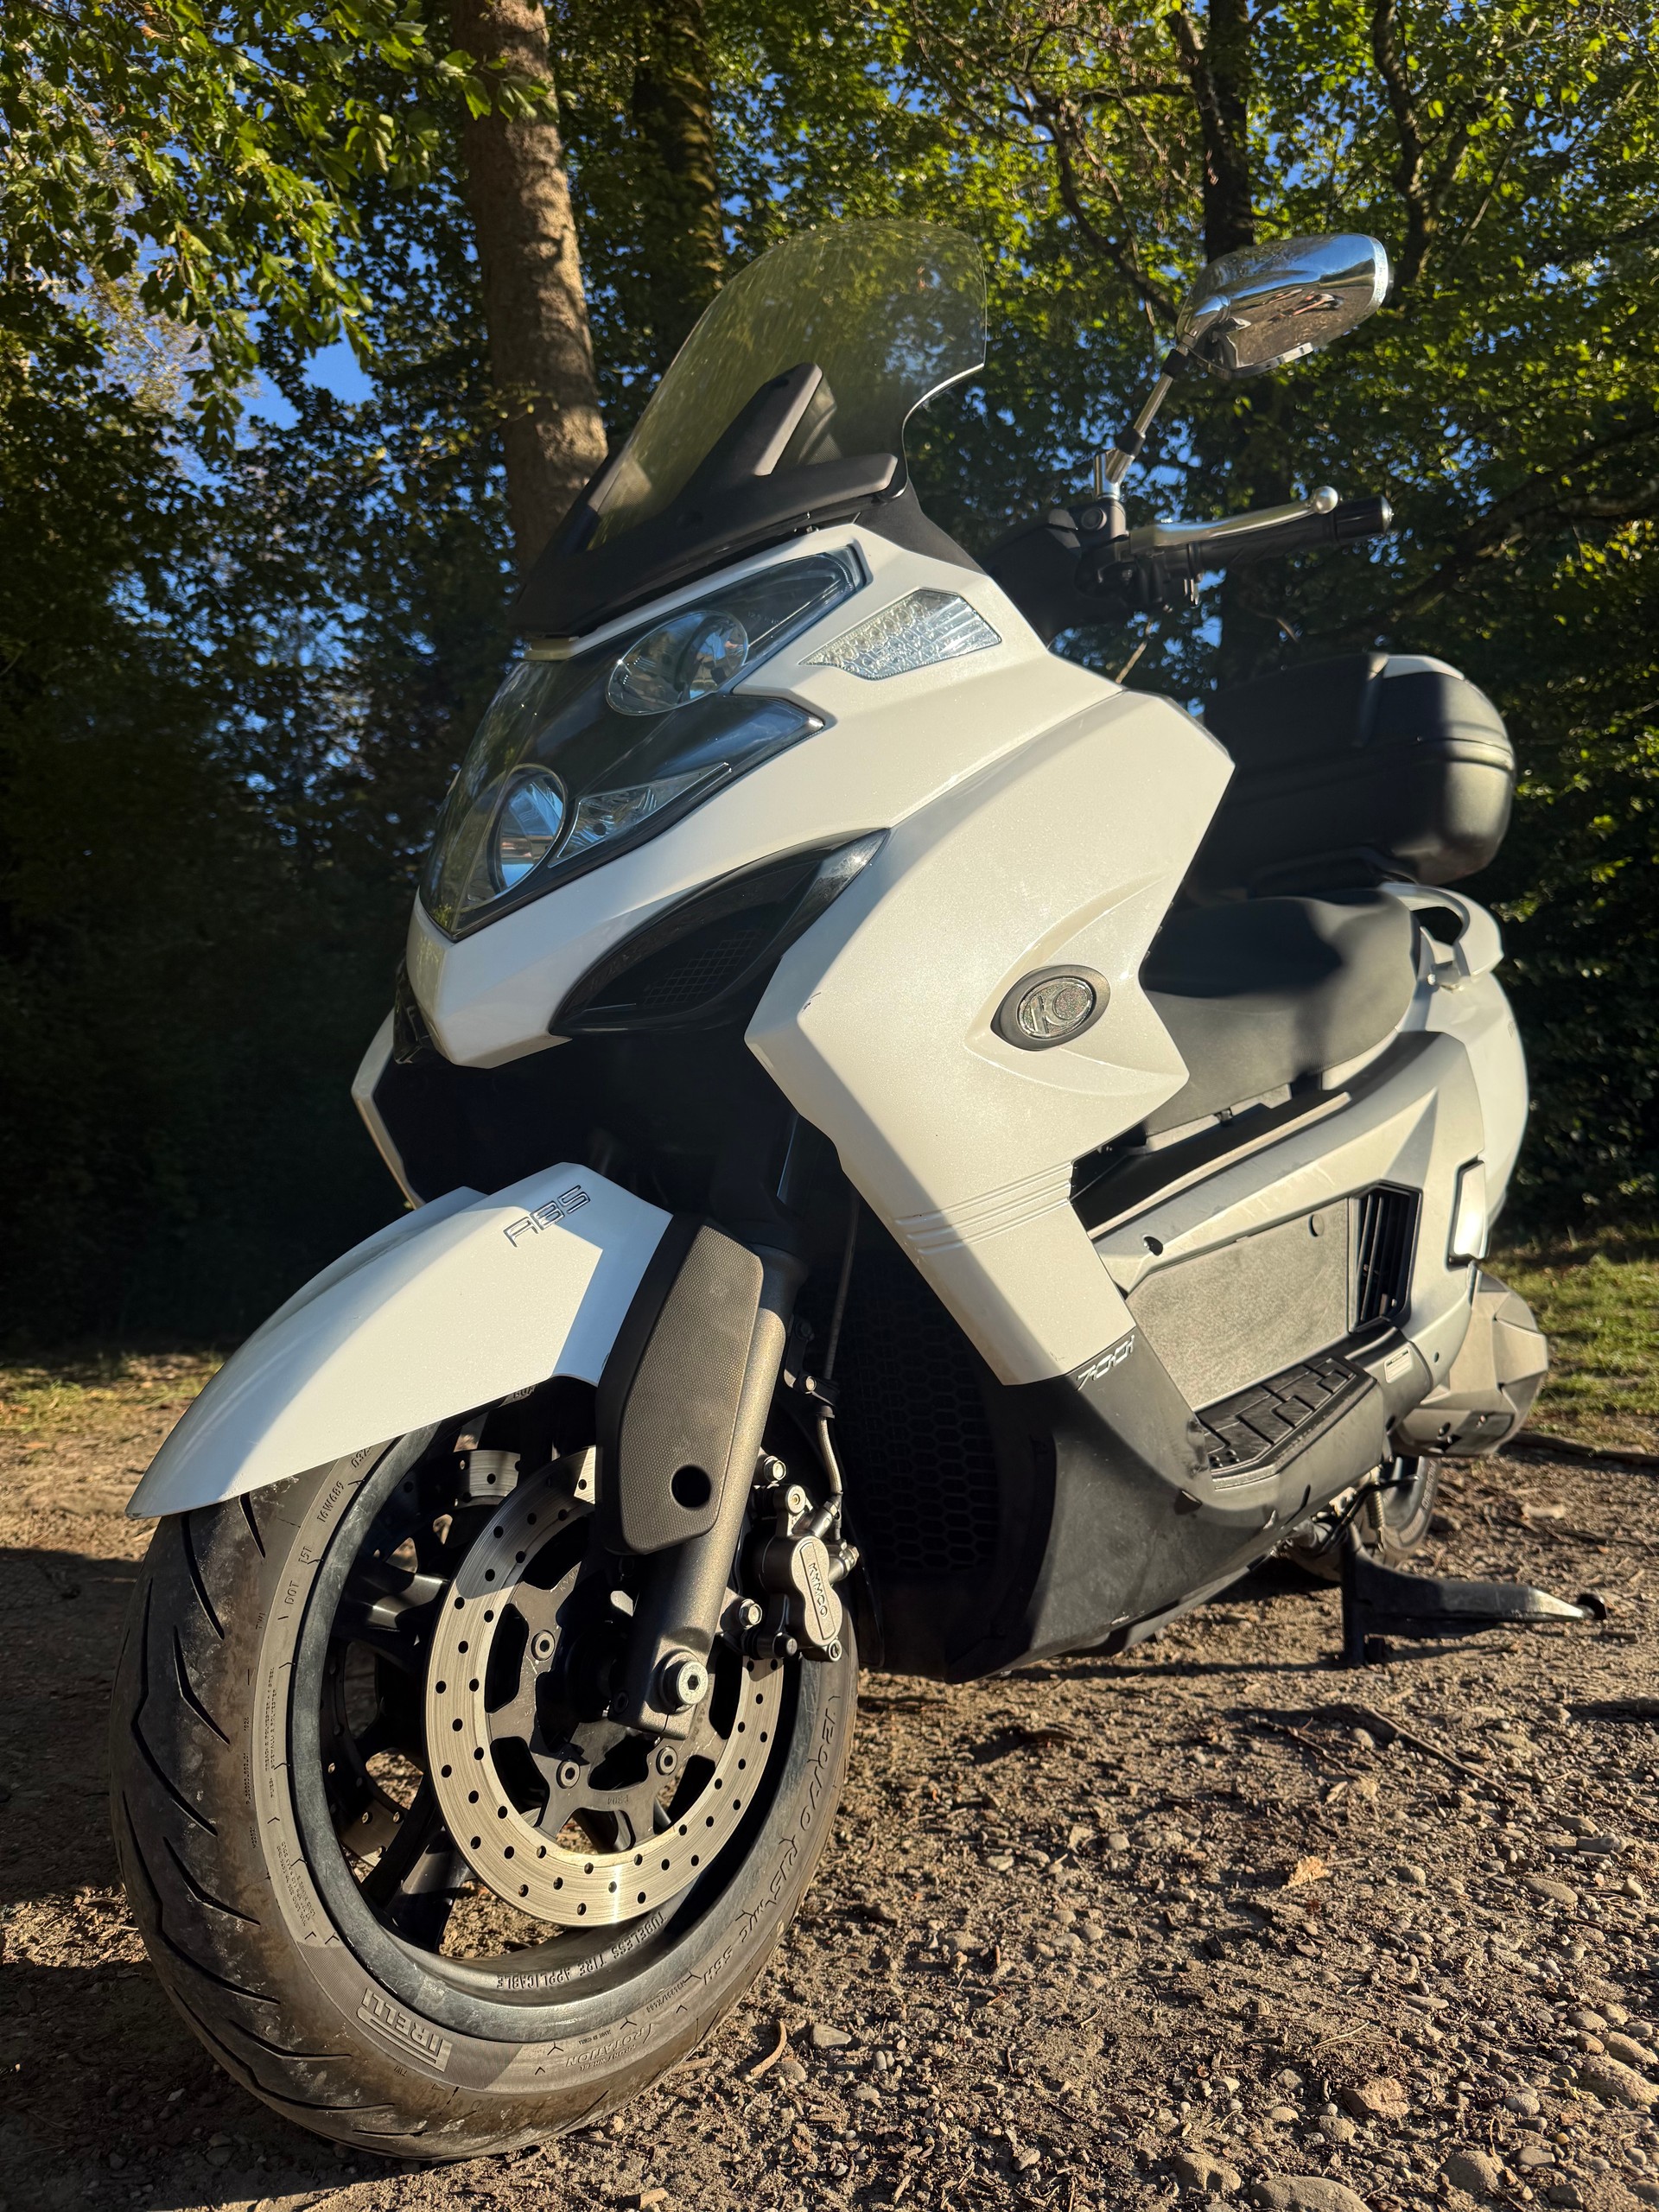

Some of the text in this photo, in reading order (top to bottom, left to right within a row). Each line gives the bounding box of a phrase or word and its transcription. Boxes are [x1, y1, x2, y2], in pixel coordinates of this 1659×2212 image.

[503, 1185, 590, 1248] ABS
[1076, 1335, 1135, 1390] 700i
[285, 1581, 299, 1605] DOT
[809, 1562, 828, 1617] KYMCO
[496, 1910, 667, 1989] TUBELESS TIRE APPLICABLE
[356, 1987, 454, 2072] PIRELLI
[566, 2030, 645, 2067] ROTATION
